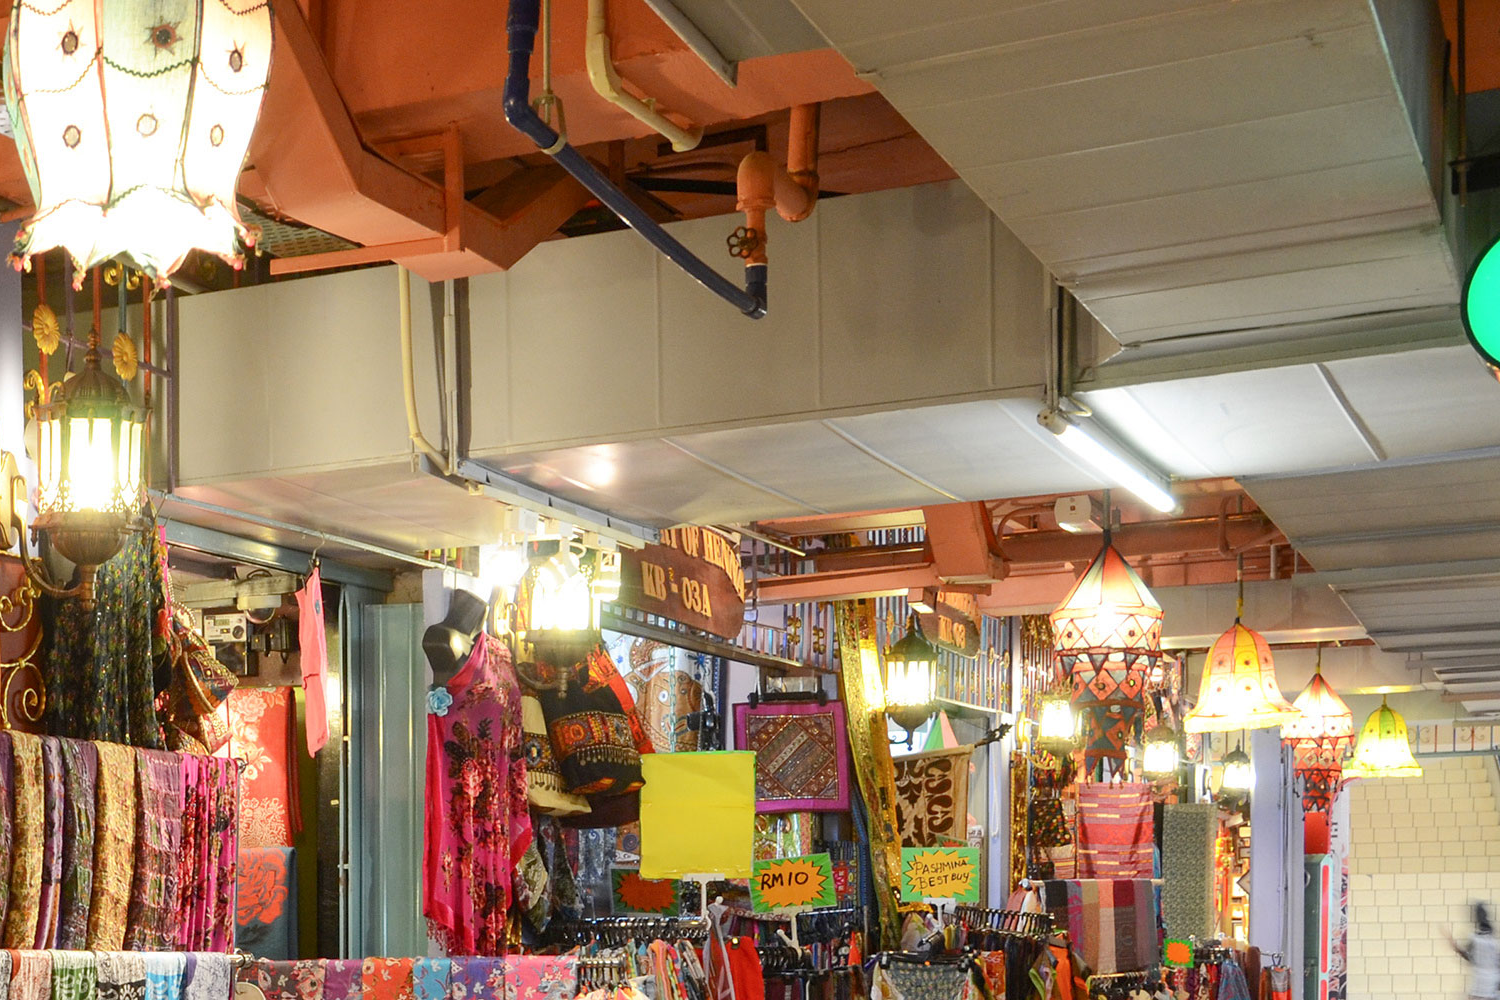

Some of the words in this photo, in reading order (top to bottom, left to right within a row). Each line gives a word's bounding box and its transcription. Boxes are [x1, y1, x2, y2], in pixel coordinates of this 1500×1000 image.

[681, 527, 700, 557] OF
[701, 528, 745, 603] HENNA
[641, 560, 667, 601] KB
[682, 577, 712, 617] 03A
[913, 859, 968, 875] PASHMINA
[916, 875, 949, 890] BEST
